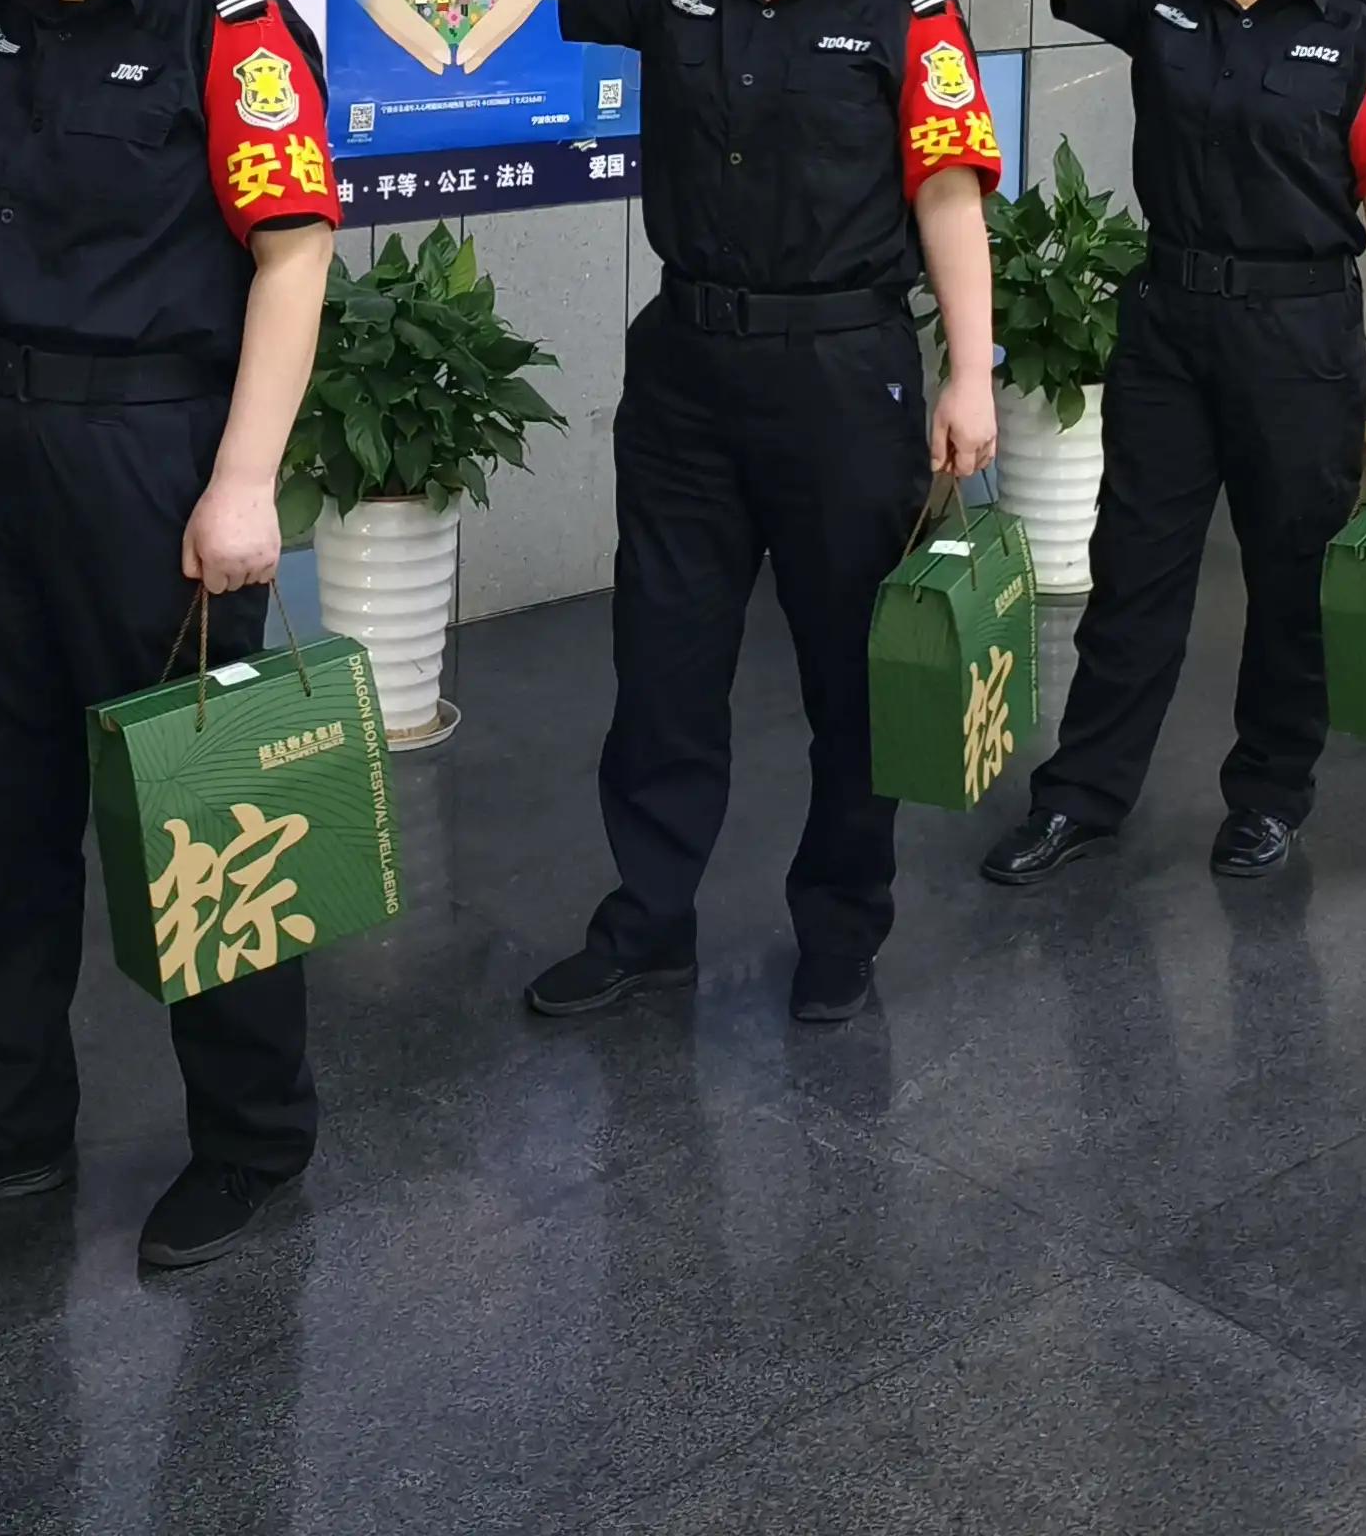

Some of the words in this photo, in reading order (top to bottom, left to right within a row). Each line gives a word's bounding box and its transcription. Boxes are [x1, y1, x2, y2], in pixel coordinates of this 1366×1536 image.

[226, 133, 328, 210] 安检
[348, 654, 373, 720] DRAGON
[362, 719, 381, 759] BOAT
[369, 761, 389, 829] FESTIVAL
[148, 802, 317, 997] 粽
[378, 827, 399, 915] WELL-BEING
